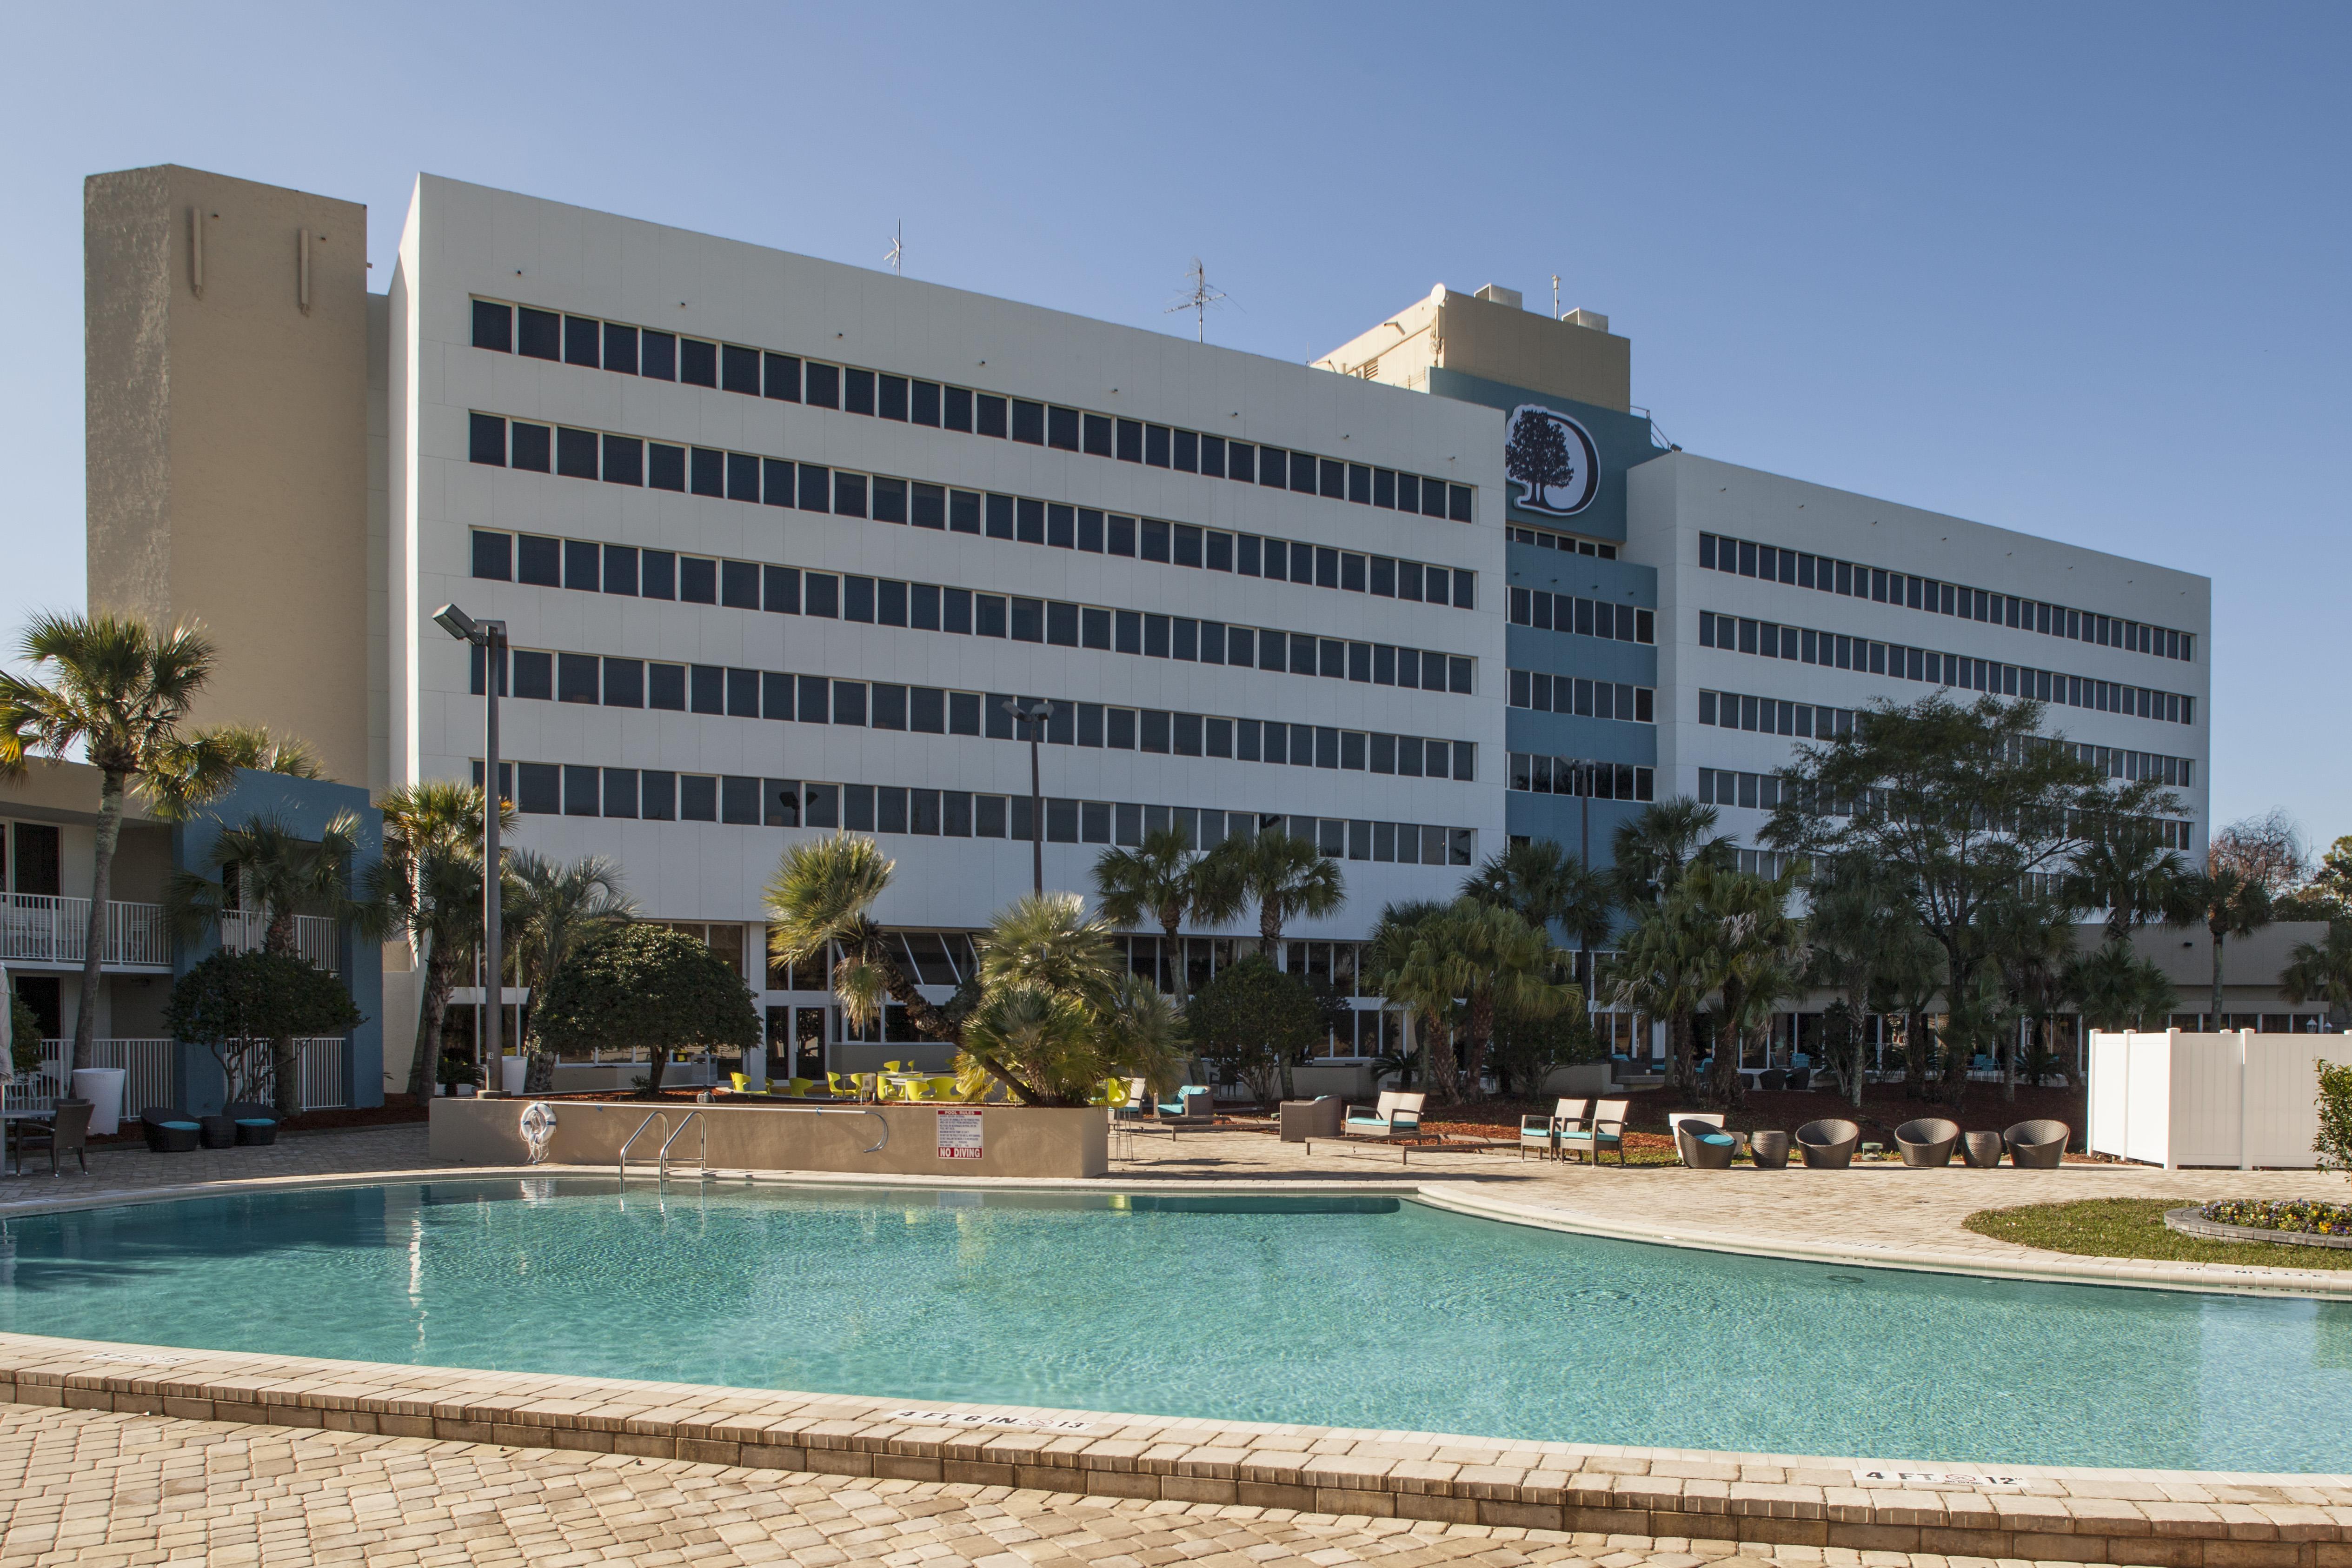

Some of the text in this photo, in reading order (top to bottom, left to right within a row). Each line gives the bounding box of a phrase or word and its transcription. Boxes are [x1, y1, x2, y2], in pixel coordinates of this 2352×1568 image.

[940, 1148, 980, 1157] NO DIVING
[1898, 1473, 1938, 1481] FT.
